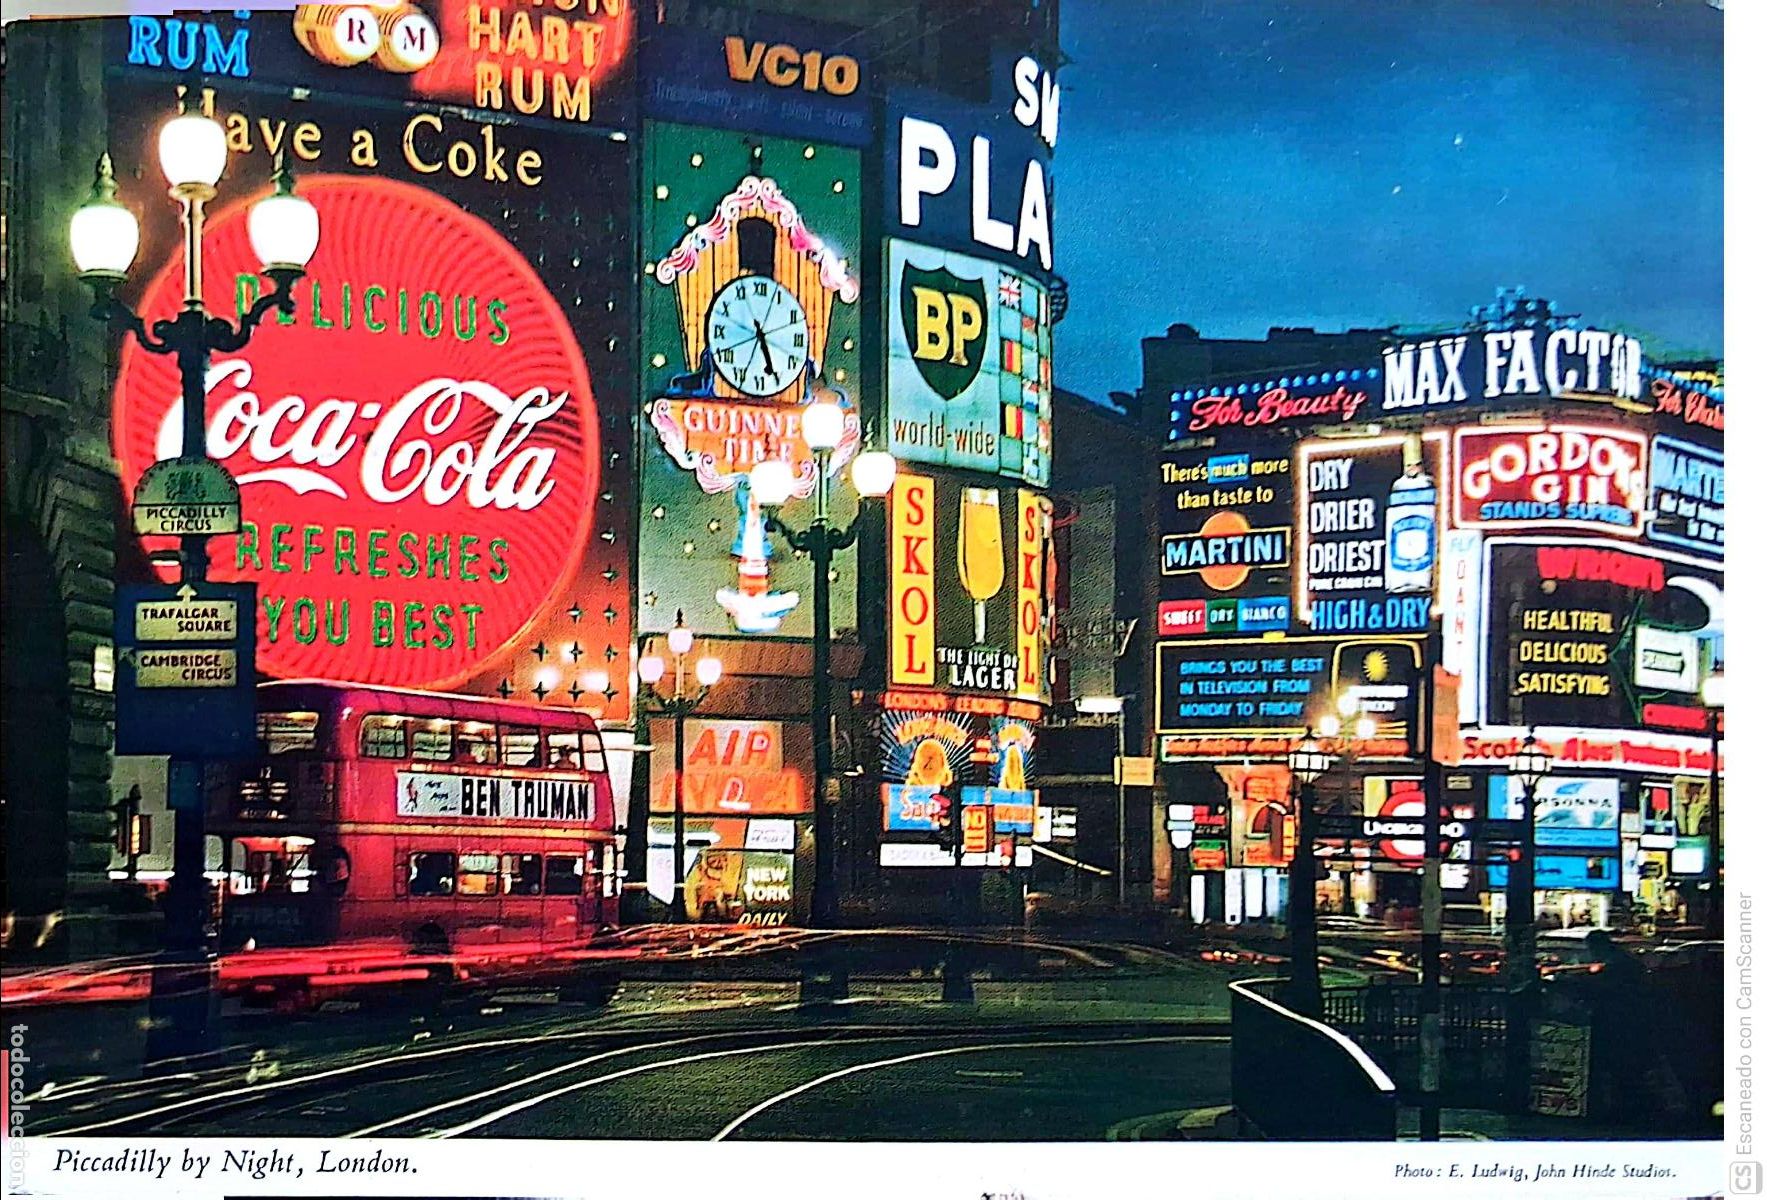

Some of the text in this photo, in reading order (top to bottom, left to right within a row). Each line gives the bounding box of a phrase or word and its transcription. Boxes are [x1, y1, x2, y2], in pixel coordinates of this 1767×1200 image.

[128, 15, 250, 77] RUM
[347, 17, 427, 53] R M
[467, 4, 605, 68] HART
[724, 36, 859, 96] VC10
[475, 61, 592, 122] RUM
[350, 117, 379, 168] a
[402, 112, 543, 187] Coke
[235, 273, 512, 346] DLICIOUS
[911, 285, 983, 367] BP
[1381, 336, 1469, 410] MAX
[684, 406, 802, 440] GUINNE
[1188, 386, 1367, 431] For Beauty
[154, 357, 570, 513] Coca-Cola
[893, 411, 995, 456] world-wide
[1161, 462, 1208, 484] There's
[1250, 459, 1289, 476] more
[1309, 458, 1353, 493] DRY
[1177, 485, 1274, 510] than taste to
[1532, 474, 1611, 505] GIN
[146, 506, 228, 519] PICCADILLY
[160, 519, 212, 532] CIRCUS
[1309, 498, 1376, 534] DRIER
[1480, 500, 1561, 521] STANDS
[235, 520, 512, 583] REFRESHES
[1165, 534, 1283, 568] MARTINI
[1308, 539, 1386, 575] DRIEST
[901, 487, 929, 674] SKOL
[1022, 506, 1038, 685] SKOL
[141, 607, 219, 619] TRAFALGAR
[177, 620, 232, 633] SQUARE
[264, 597, 484, 650] YOU BEST
[1311, 597, 1366, 631] HIGH
[1384, 596, 1432, 629] DRY
[1522, 609, 1615, 634] HEALTHFUL
[140, 655, 222, 668] CAMBRIDGE
[936, 646, 964, 665] THE
[968, 648, 1001, 667] LIGHT
[1229, 659, 1258, 674] YOU
[1260, 659, 1286, 673] THE
[1291, 657, 1325, 673] BEST
[1519, 640, 1610, 664] DELICIOUS
[181, 668, 232, 682] CIRCUS
[950, 664, 1017, 692] LAGER
[1517, 671, 1611, 696] SATISFYING
[1235, 702, 1255, 716] TO
[461, 778, 589, 820] BEN TRUMAN
[746, 867, 788, 882] NEW
[743, 886, 791, 902] YORK
[737, 912, 788, 926] DAILY
